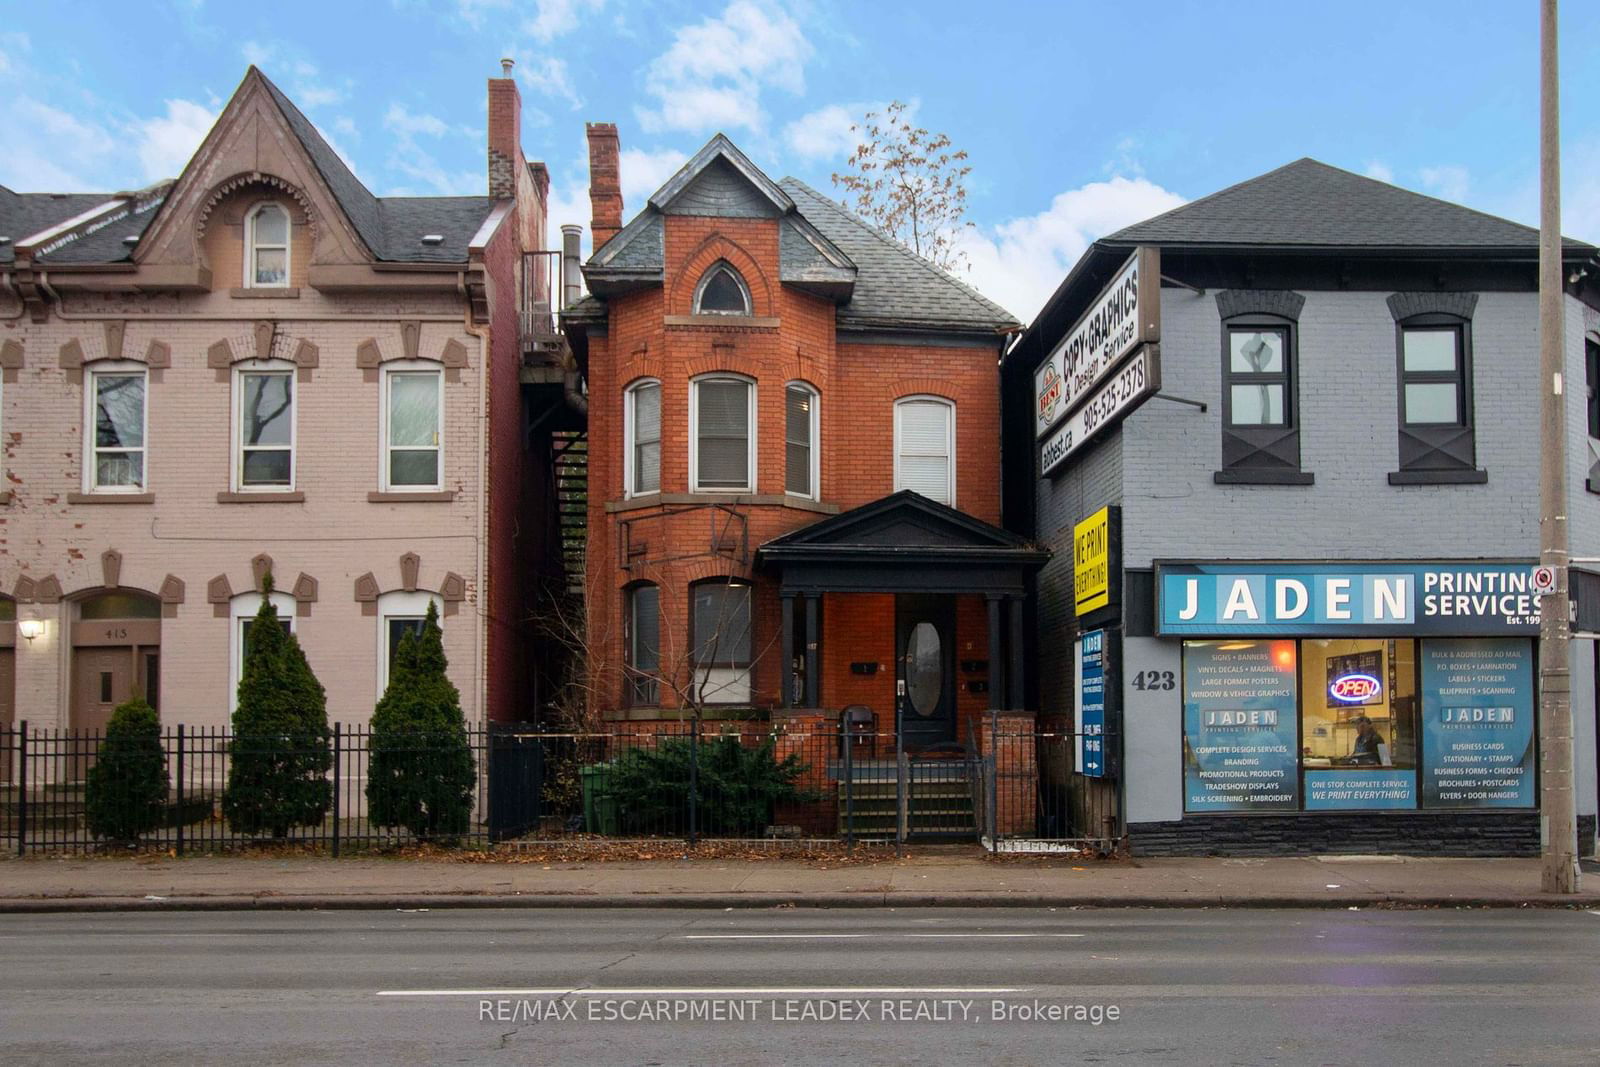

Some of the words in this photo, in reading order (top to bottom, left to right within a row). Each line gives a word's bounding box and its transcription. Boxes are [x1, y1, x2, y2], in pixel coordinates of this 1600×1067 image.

[1065, 384, 1071, 404] &
[1075, 360, 1098, 394] Design
[1103, 320, 1134, 362] Service
[1040, 383, 1060, 412] BEST
[1084, 359, 1144, 435] 905-525-2378
[1042, 430, 1072, 470] abbest.ca
[1076, 534, 1084, 568] WE
[1087, 522, 1106, 560] PRINT
[1178, 578, 1406, 620] JADEN
[1424, 594, 1541, 616] SERVICES
[1506, 616, 1522, 624] Est.
[104, 629, 128, 639] 415
[1132, 670, 1176, 691] 423
[1335, 680, 1374, 695] OPEN
[1208, 711, 1274, 725] JADEN
[1446, 708, 1511, 722] JADEN
[1312, 792, 1325, 800] WE
[1354, 791, 1409, 799] EVERYTHING!
